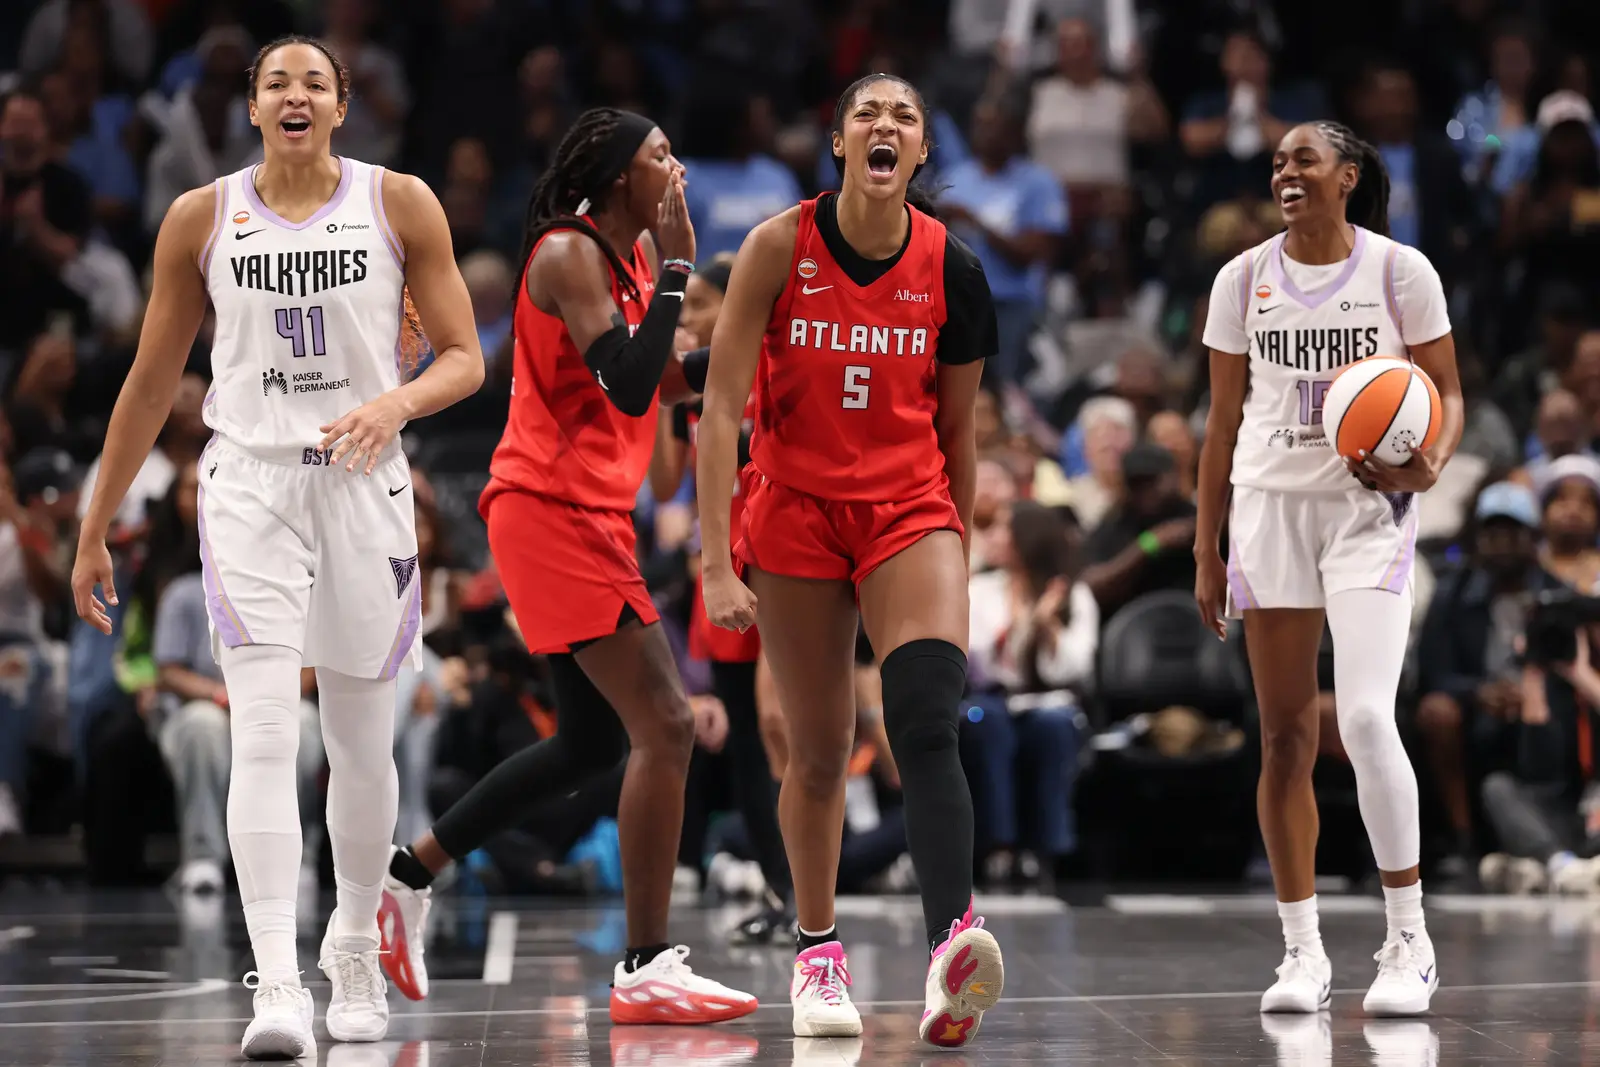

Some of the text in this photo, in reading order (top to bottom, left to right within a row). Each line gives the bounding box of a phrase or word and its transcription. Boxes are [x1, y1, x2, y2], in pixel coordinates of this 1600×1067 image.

[341, 223, 369, 232] freedom
[230, 250, 368, 298] VALKYRIES
[893, 289, 929, 302] Albert
[274, 306, 326, 358] 41
[789, 317, 927, 355] ATLANTA
[1255, 327, 1379, 372] VALKYRIES
[292, 371, 323, 382] KAISER
[293, 378, 350, 393] PERMANENTE
[842, 364, 872, 410] 5
[301, 446, 334, 466] GSV
